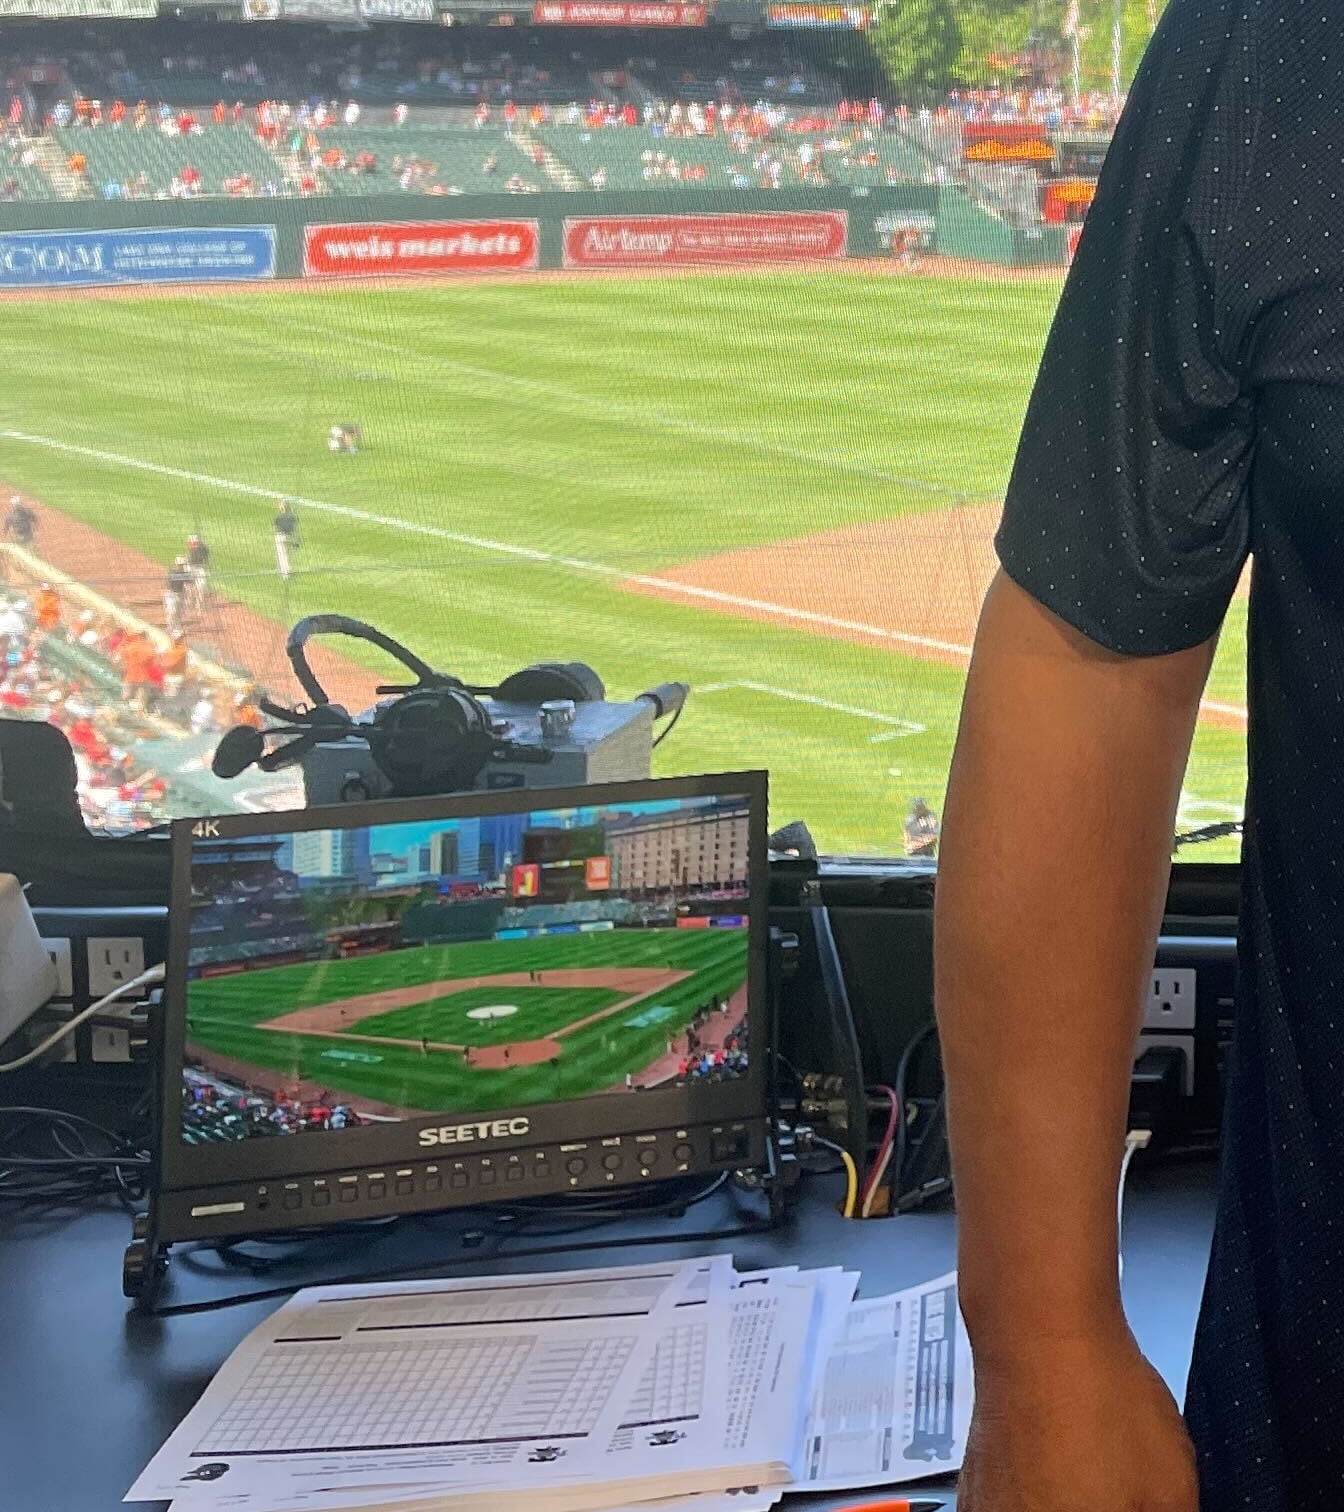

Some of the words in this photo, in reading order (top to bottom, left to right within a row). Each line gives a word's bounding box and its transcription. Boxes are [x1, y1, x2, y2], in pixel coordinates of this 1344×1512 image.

[324, 234, 393, 260] weis
[398, 231, 521, 258] markets
[192, 819, 220, 837] 4K
[418, 1117, 529, 1147] SEETEC
